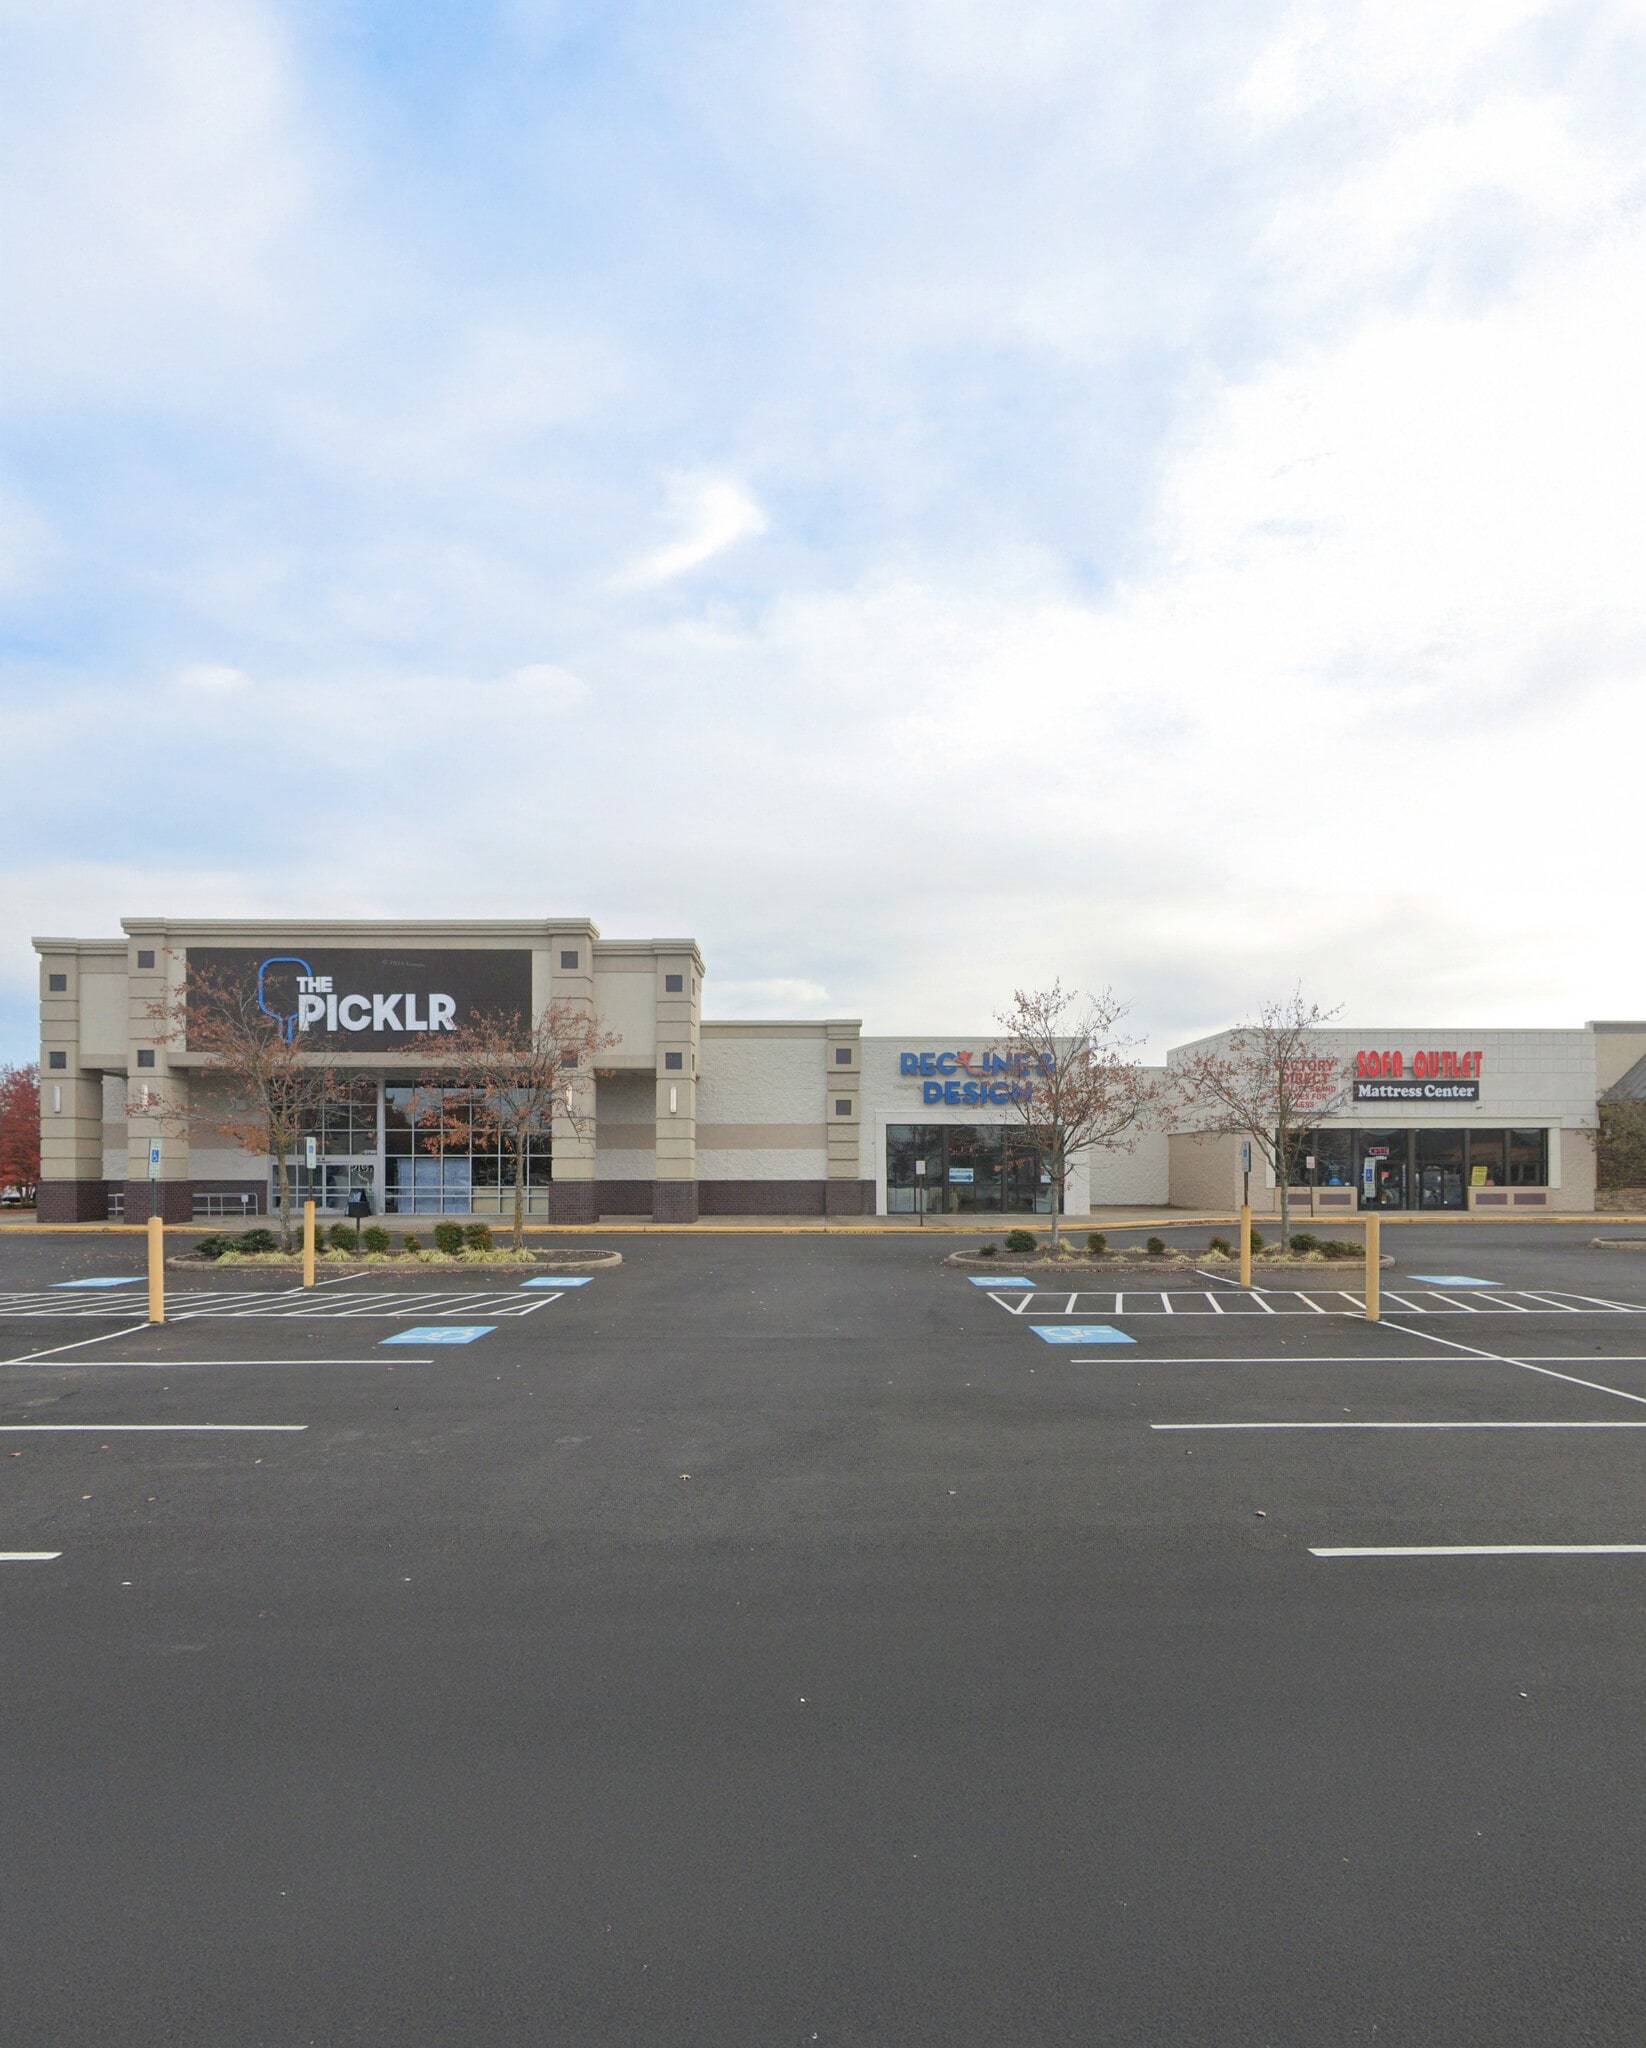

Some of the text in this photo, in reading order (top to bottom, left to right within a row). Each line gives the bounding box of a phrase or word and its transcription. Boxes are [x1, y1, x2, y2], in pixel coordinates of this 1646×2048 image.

[296, 976, 333, 993] THE
[298, 993, 458, 1032] PICKLR
[1356, 1050, 1483, 1078] SOFA OUTLET
[1358, 1084, 1475, 1098] Mattress Center
